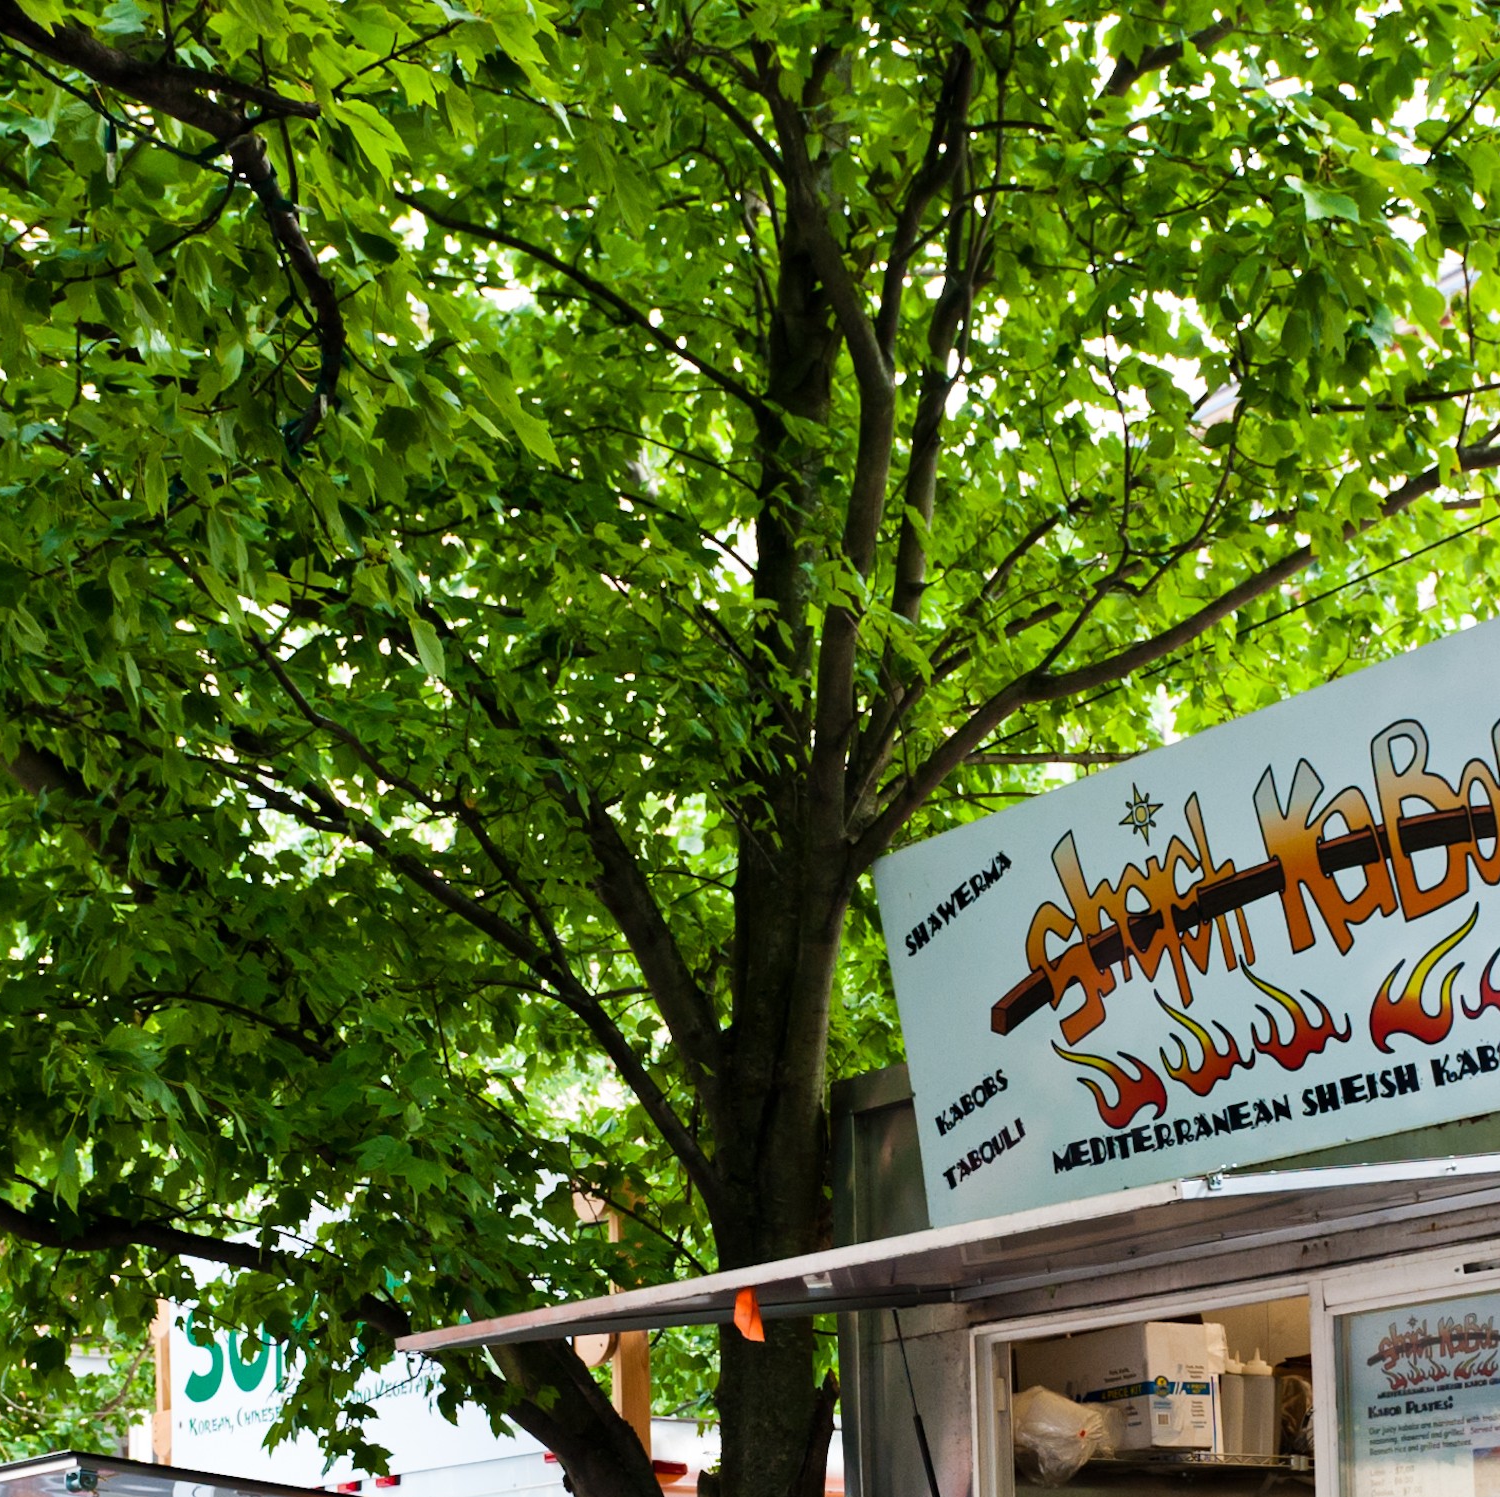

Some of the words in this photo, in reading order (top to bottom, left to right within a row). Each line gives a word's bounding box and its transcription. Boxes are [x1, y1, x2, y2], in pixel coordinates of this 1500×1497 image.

[906, 852, 1012, 957] SHAWERMA
[936, 1069, 1008, 1136] KABOBS
[1053, 1095, 1291, 1174] MEDITERRANEAN
[1301, 1062, 1420, 1116] SHEISH
[943, 1118, 1027, 1189] TABOULI
[1405, 1396, 1453, 1415] PLATES:
